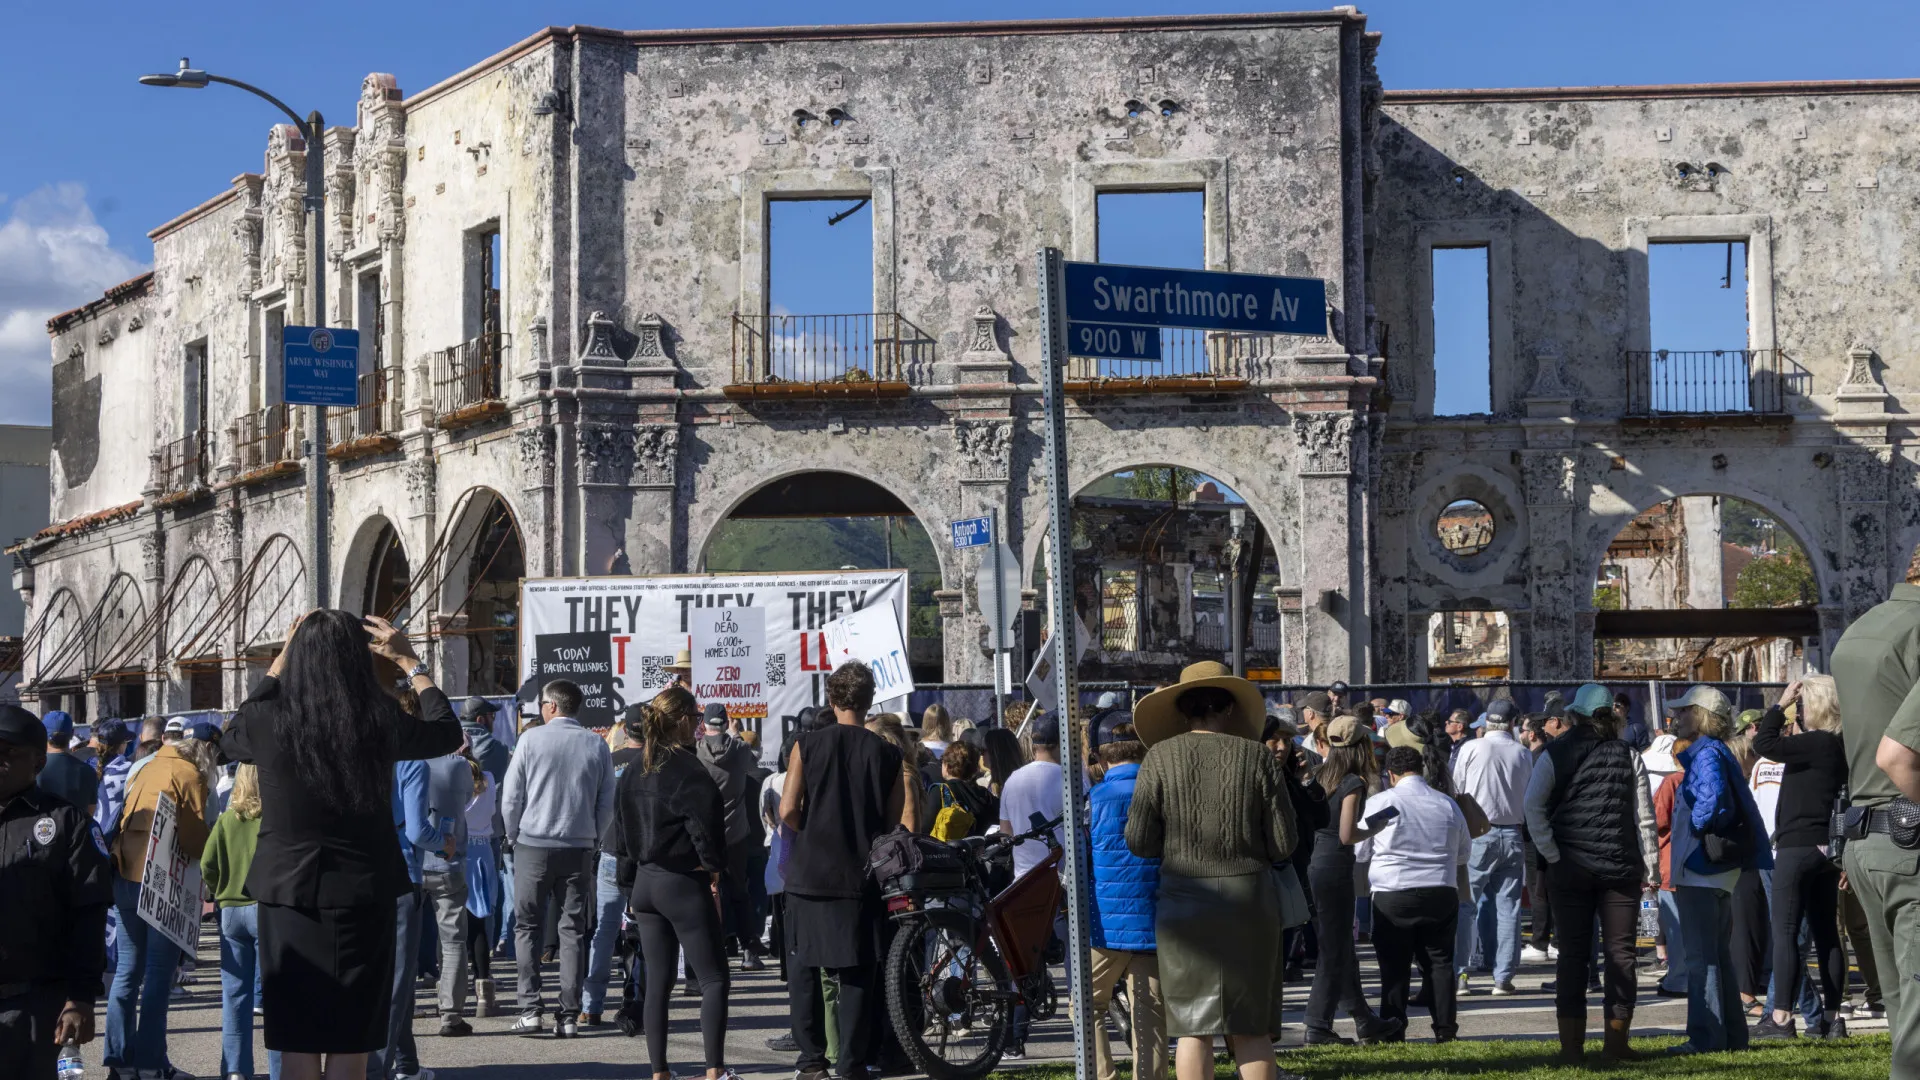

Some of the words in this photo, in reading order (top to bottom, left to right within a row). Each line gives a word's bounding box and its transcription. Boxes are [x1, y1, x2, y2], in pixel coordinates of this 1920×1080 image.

[1093, 276, 1258, 320] Swarthmore
[1270, 288, 1300, 322] Av
[1080, 327, 1121, 354] 900
[1131, 330, 1147, 355] W
[288, 356, 312, 367] ARNIE
[315, 357, 354, 369] WISHNICK
[313, 369, 329, 379] WAY
[954, 522, 977, 538] Antioch
[981, 518, 989, 534] St
[588, 584, 608, 592] OFFICIALS
[564, 595, 642, 633] THEY
[787, 590, 867, 631] THEY
[722, 610, 732, 621] 12
[714, 622, 739, 633] DEAD
[553, 646, 591, 661] TODAY
[704, 647, 729, 658] HOMES
[731, 645, 751, 658] LOST
[800, 631, 832, 671] LE
[543, 662, 571, 674] PACIFIC
[573, 661, 609, 674] PALISADES
[716, 666, 741, 681] ZERO
[871, 650, 904, 692] OUT
[695, 682, 761, 699] ACCOUNTABILITY!
[585, 697, 608, 708] CODE
[152, 811, 167, 840] EY
[168, 853, 189, 887] LET
[169, 878, 183, 909] US
[155, 896, 186, 940] BURN!
